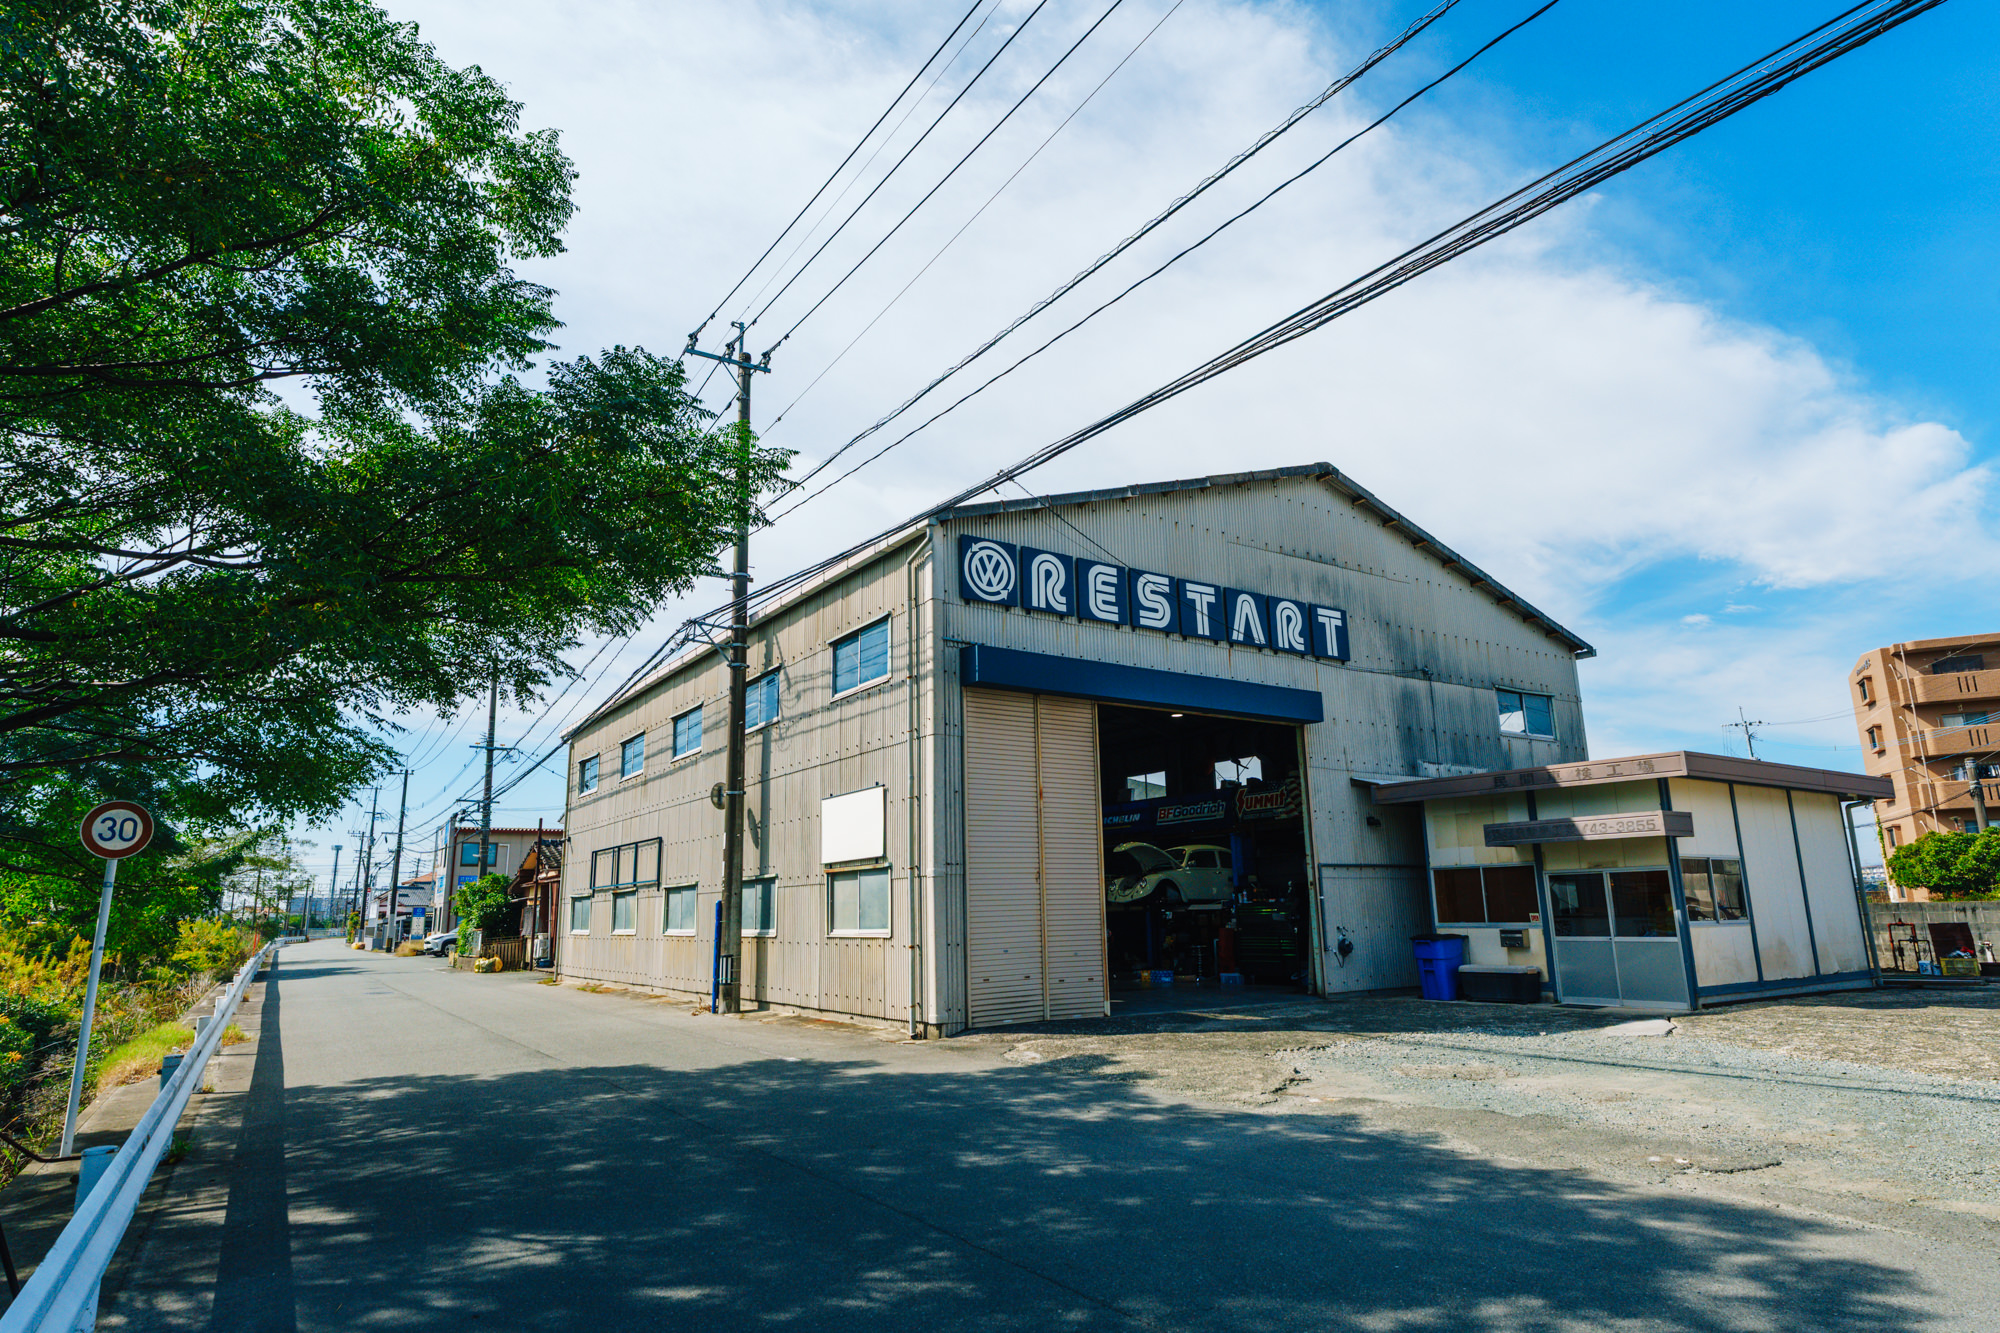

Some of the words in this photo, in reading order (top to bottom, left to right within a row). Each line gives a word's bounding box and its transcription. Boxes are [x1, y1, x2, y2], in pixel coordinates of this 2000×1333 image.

[1031, 553, 1343, 657] RESTART
[1104, 813, 1140, 825] ICHELIN
[1158, 800, 1225, 821] BFGoodrich
[98, 817, 138, 842] 30
